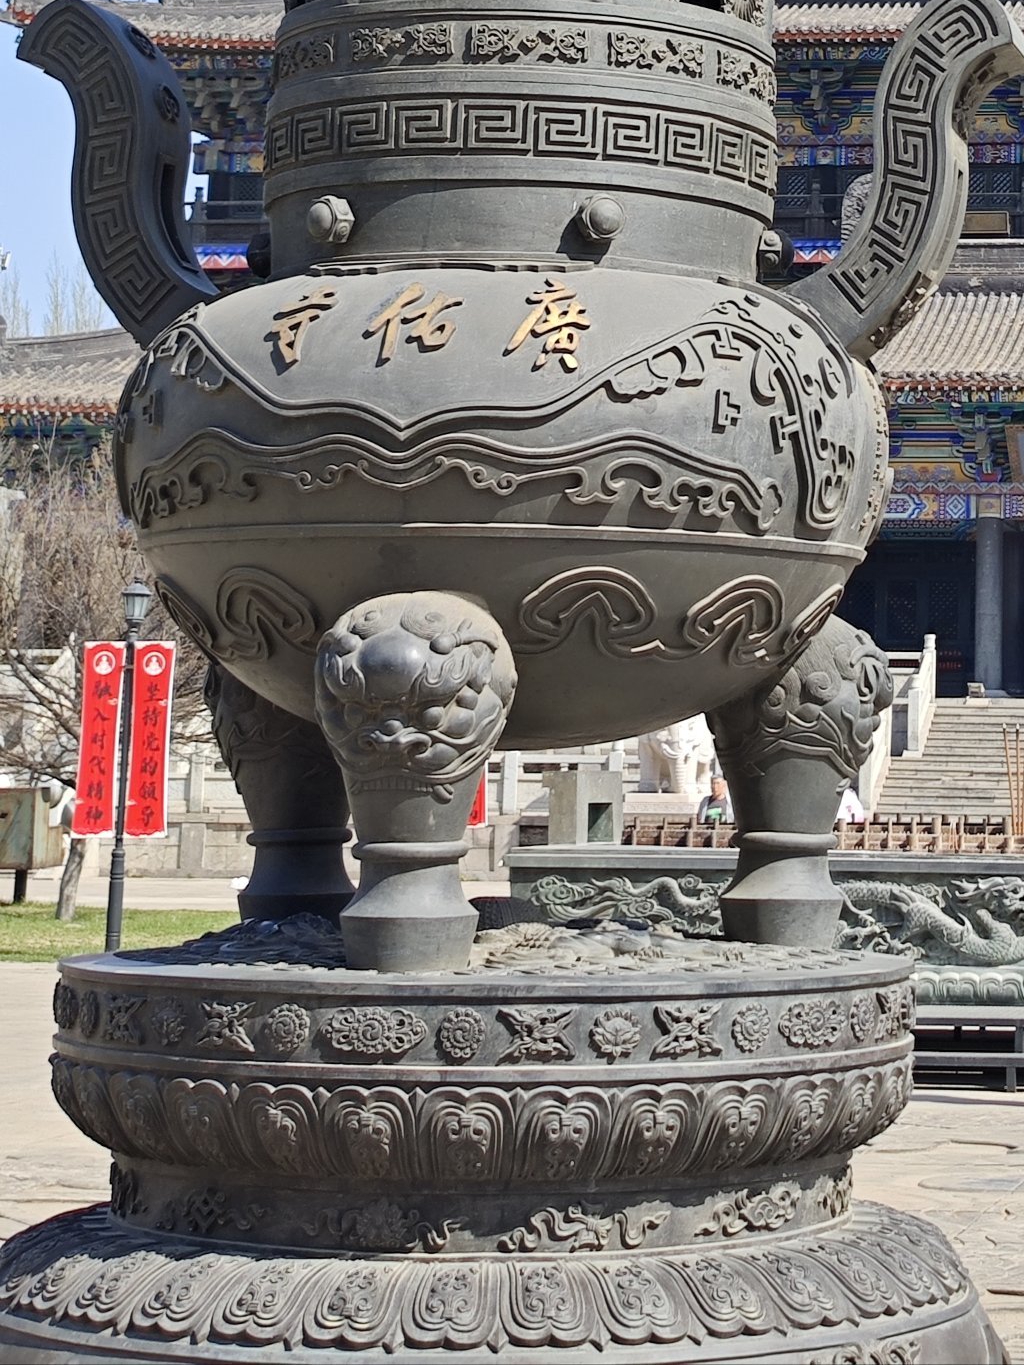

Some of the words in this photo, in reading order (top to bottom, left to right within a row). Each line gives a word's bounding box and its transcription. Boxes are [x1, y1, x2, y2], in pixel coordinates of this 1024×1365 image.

[84, 680, 113, 826] 融入时代精神
[138, 681, 164, 827] 坚持党的领导
